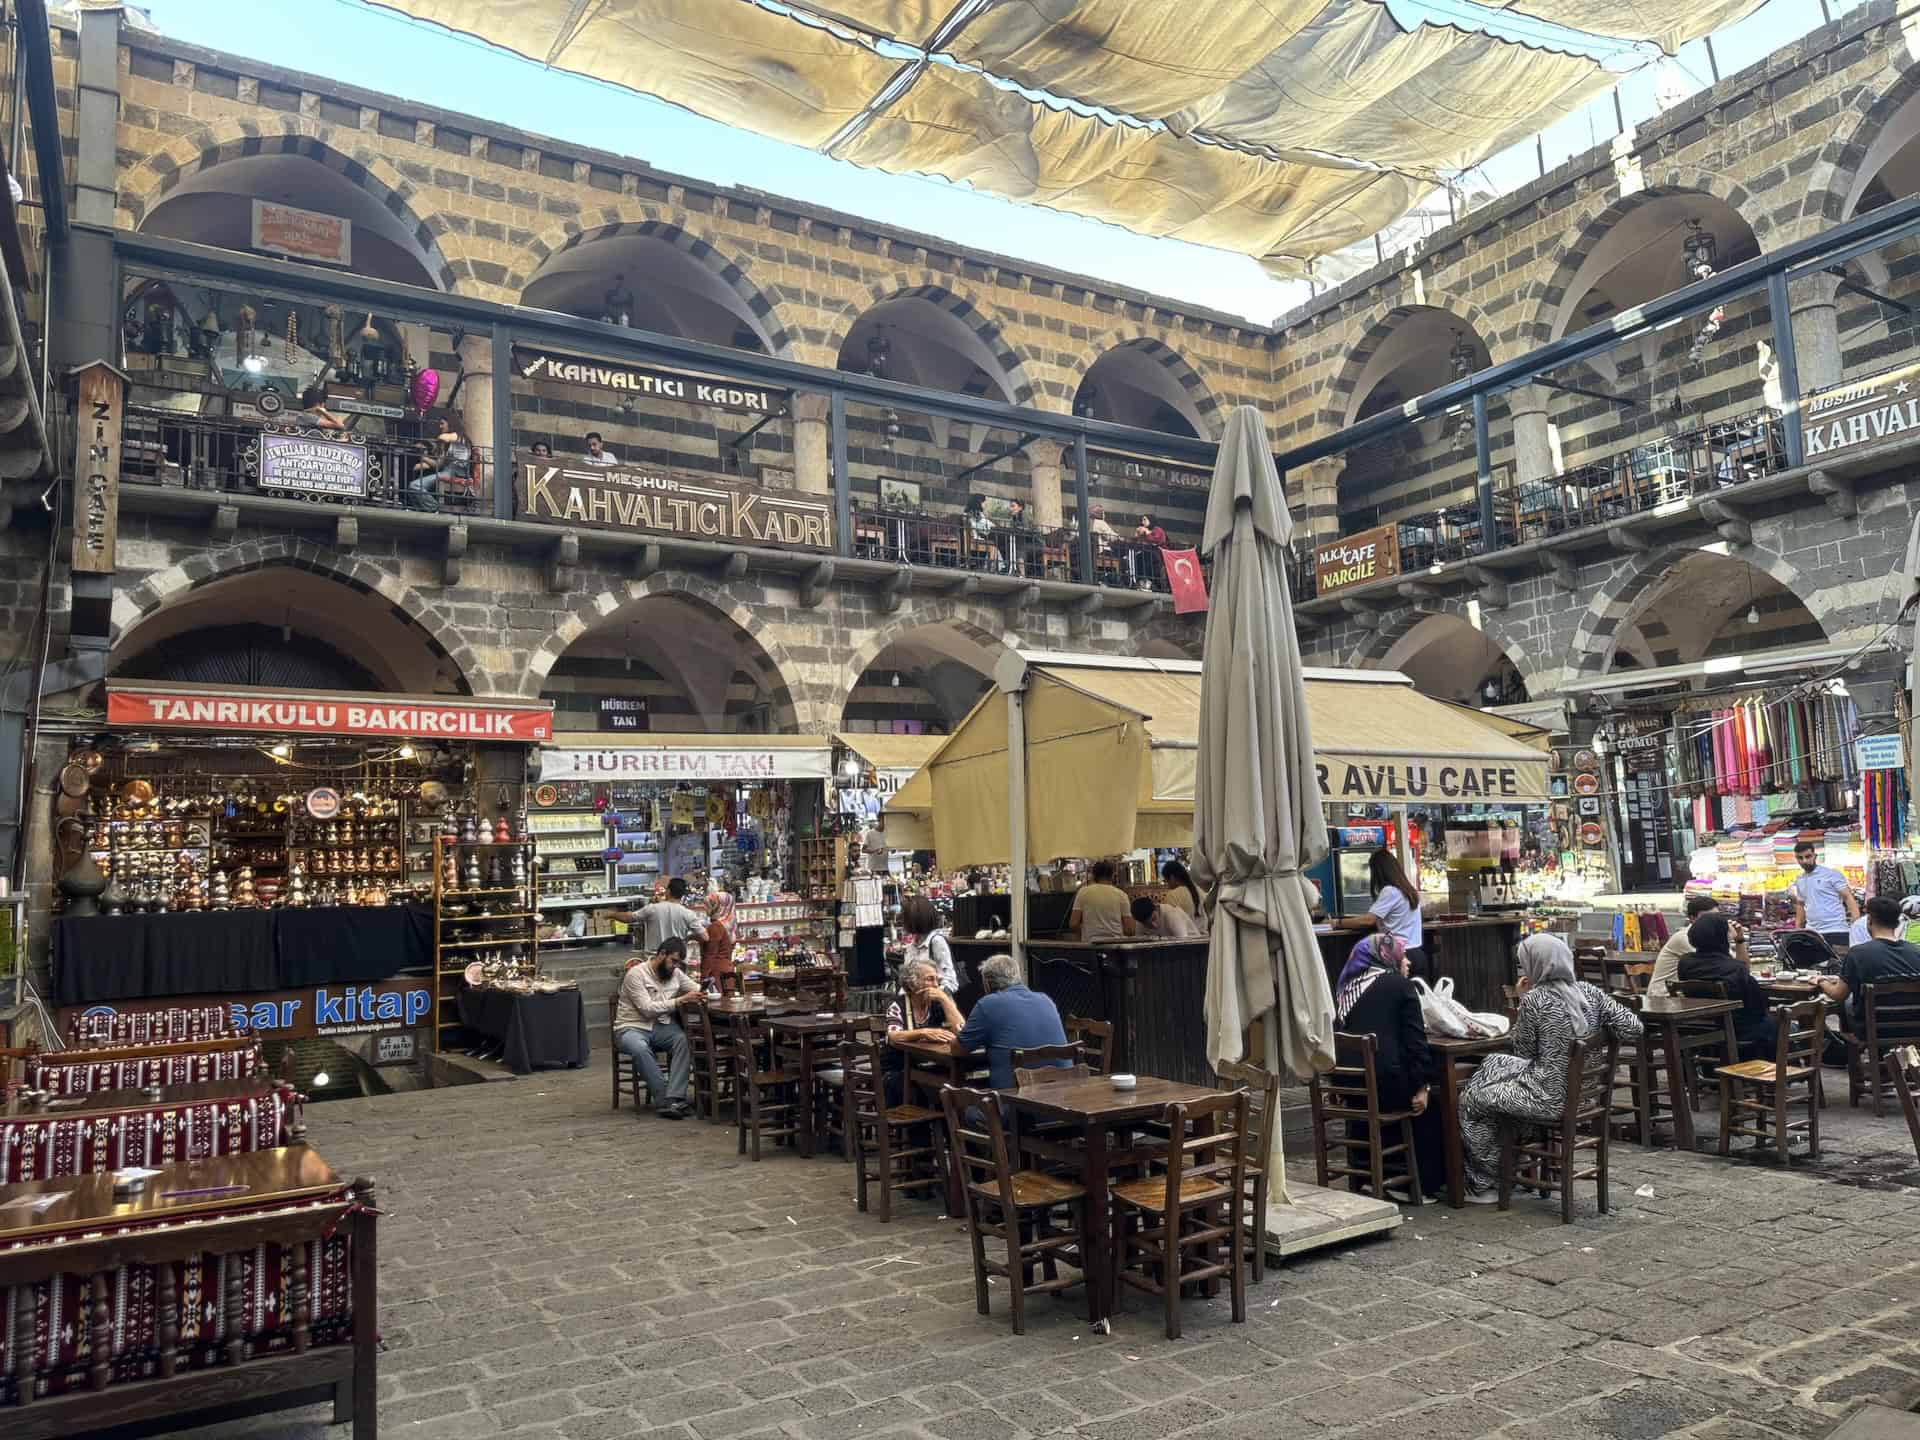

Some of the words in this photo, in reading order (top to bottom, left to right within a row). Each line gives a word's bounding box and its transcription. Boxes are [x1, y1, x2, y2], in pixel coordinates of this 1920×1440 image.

[547, 360, 685, 397] KAHVALTICI
[1805, 399, 1920, 456] KAHVAL
[317, 446, 341, 460] SILVER
[311, 473, 322, 481] AND
[1343, 543, 1376, 566] CAFE
[1322, 560, 1376, 590] NARGİLE
[148, 698, 337, 726] TANRIKULU
[347, 708, 515, 734] BAKIRCILIK
[601, 698, 646, 711] HÜRREM
[612, 715, 637, 726] TAKI
[573, 750, 707, 771] HÜRREM
[714, 754, 775, 771] TAKI
[1342, 764, 1428, 796] AVLU
[1439, 766, 1517, 797] CAFE
[315, 985, 431, 1025] kitap
